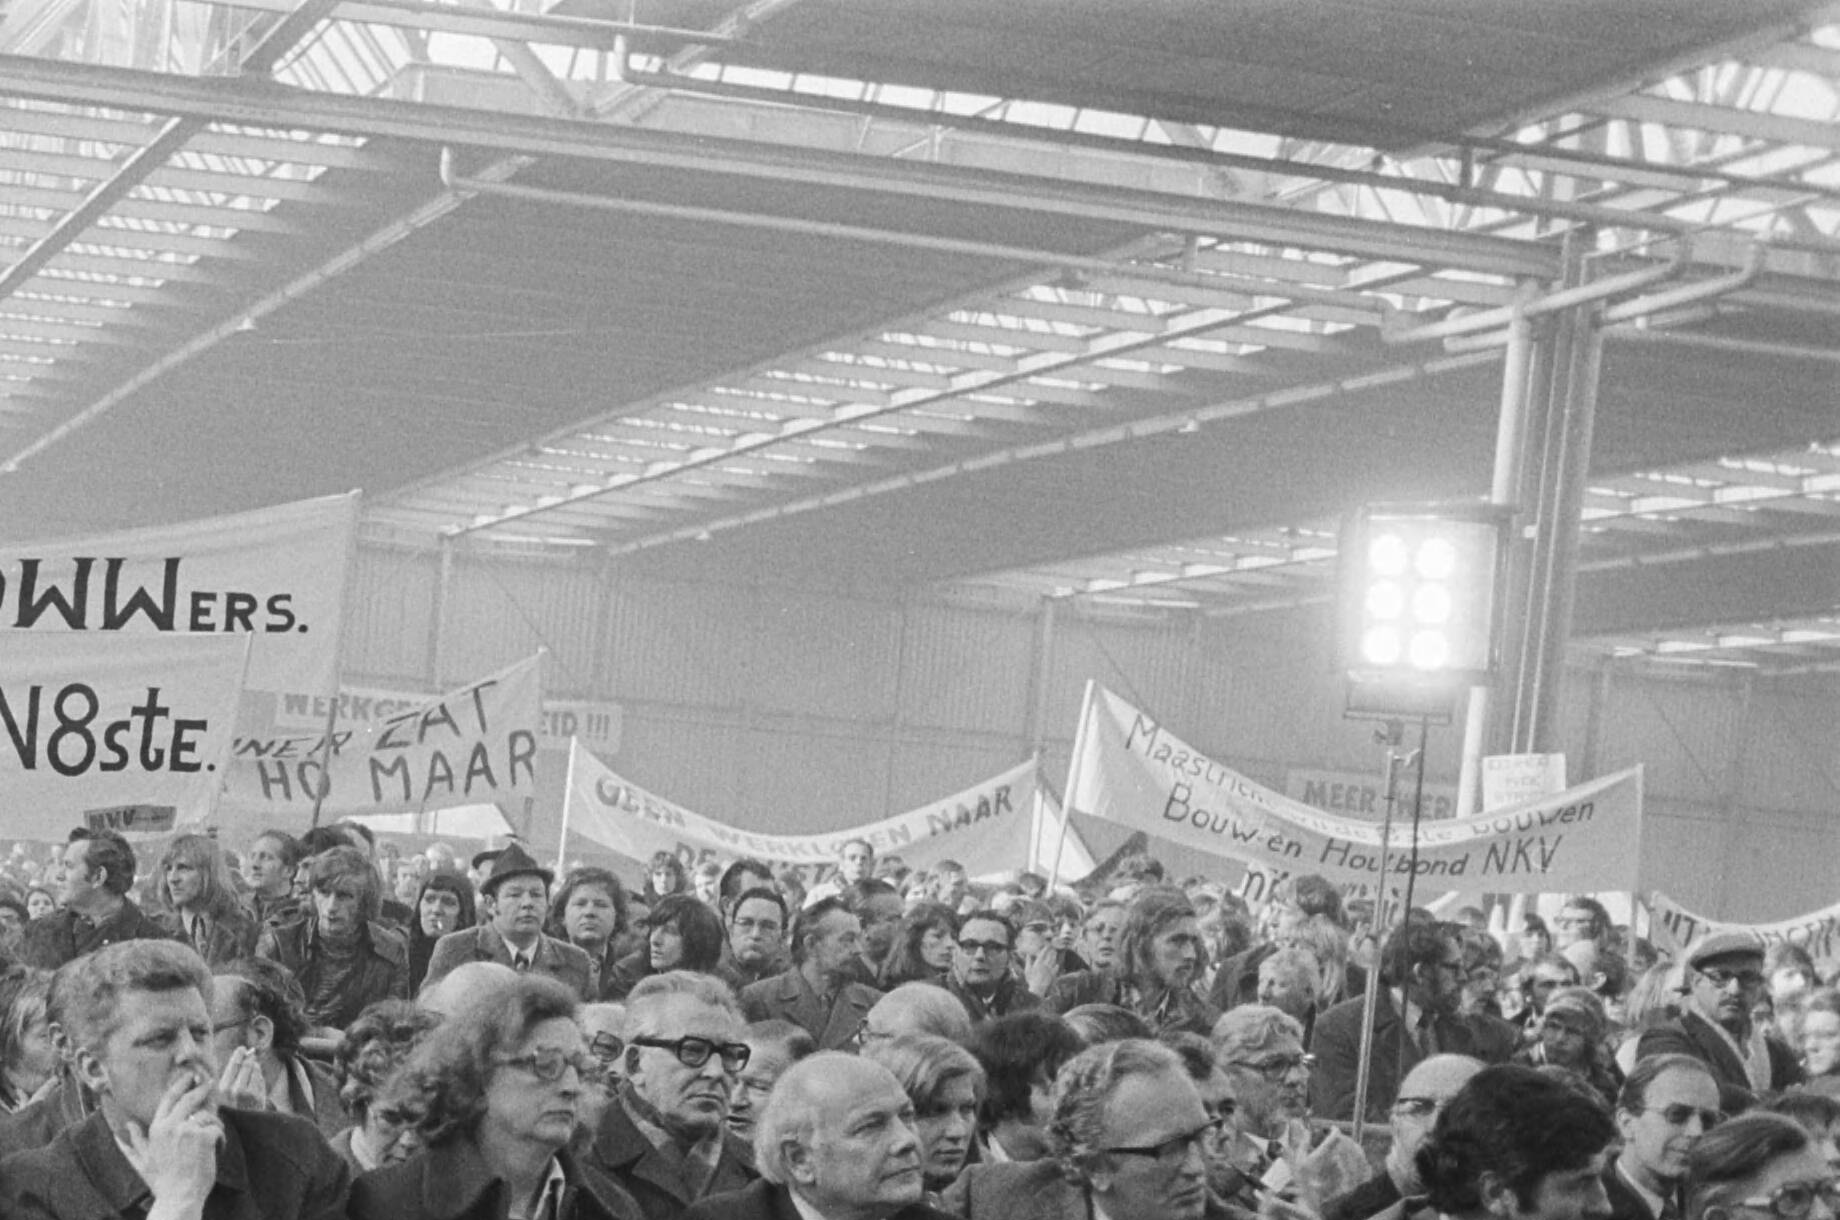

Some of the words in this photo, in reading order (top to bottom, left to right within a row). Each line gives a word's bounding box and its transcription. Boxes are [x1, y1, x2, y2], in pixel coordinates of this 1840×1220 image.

[374, 680, 498, 751] ZAT
[368, 730, 537, 803] MAAR
[927, 784, 1014, 837] NAAR
[1303, 779, 1377, 814] MEER
[1482, 834, 1563, 875] NKV
